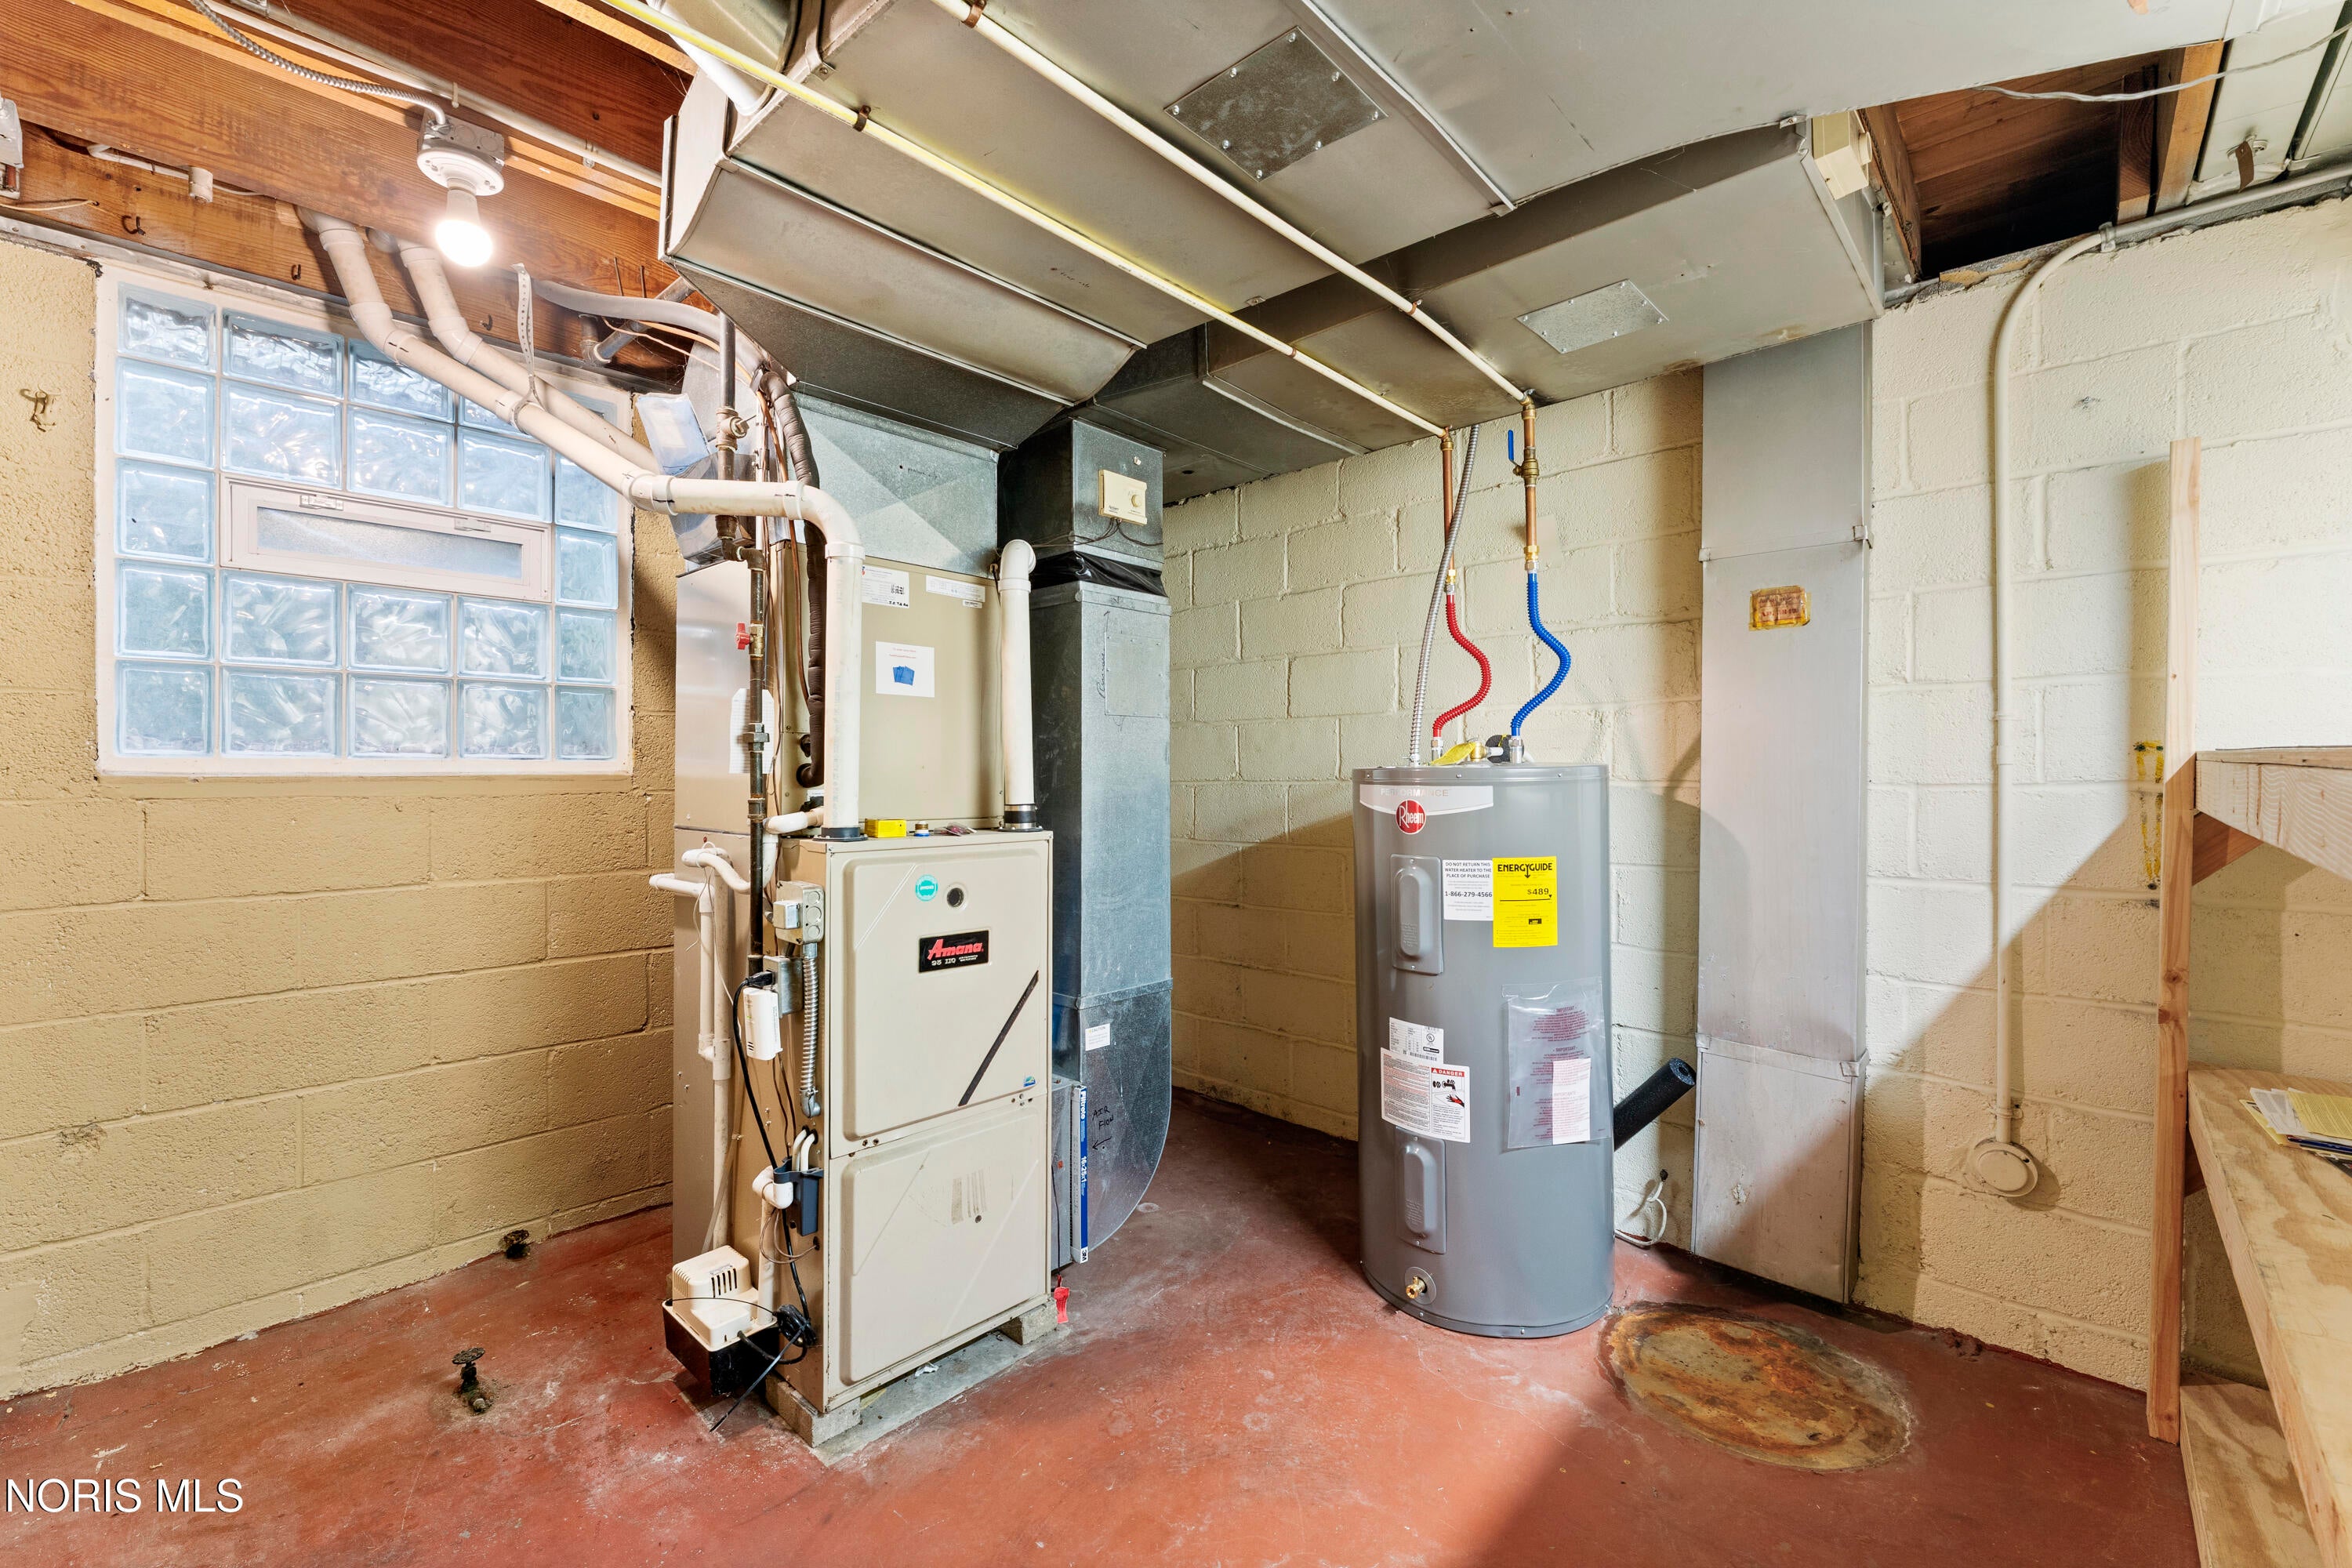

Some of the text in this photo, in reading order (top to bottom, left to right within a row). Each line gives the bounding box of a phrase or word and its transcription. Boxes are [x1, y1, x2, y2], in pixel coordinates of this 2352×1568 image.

[1381, 788, 1449, 797] PERFORMANCE
[1399, 799, 1424, 829] Rheem
[927, 938, 982, 960] Amana
[1092, 1105, 1110, 1121] AIR
[1081, 1250, 1087, 1261] 3M
